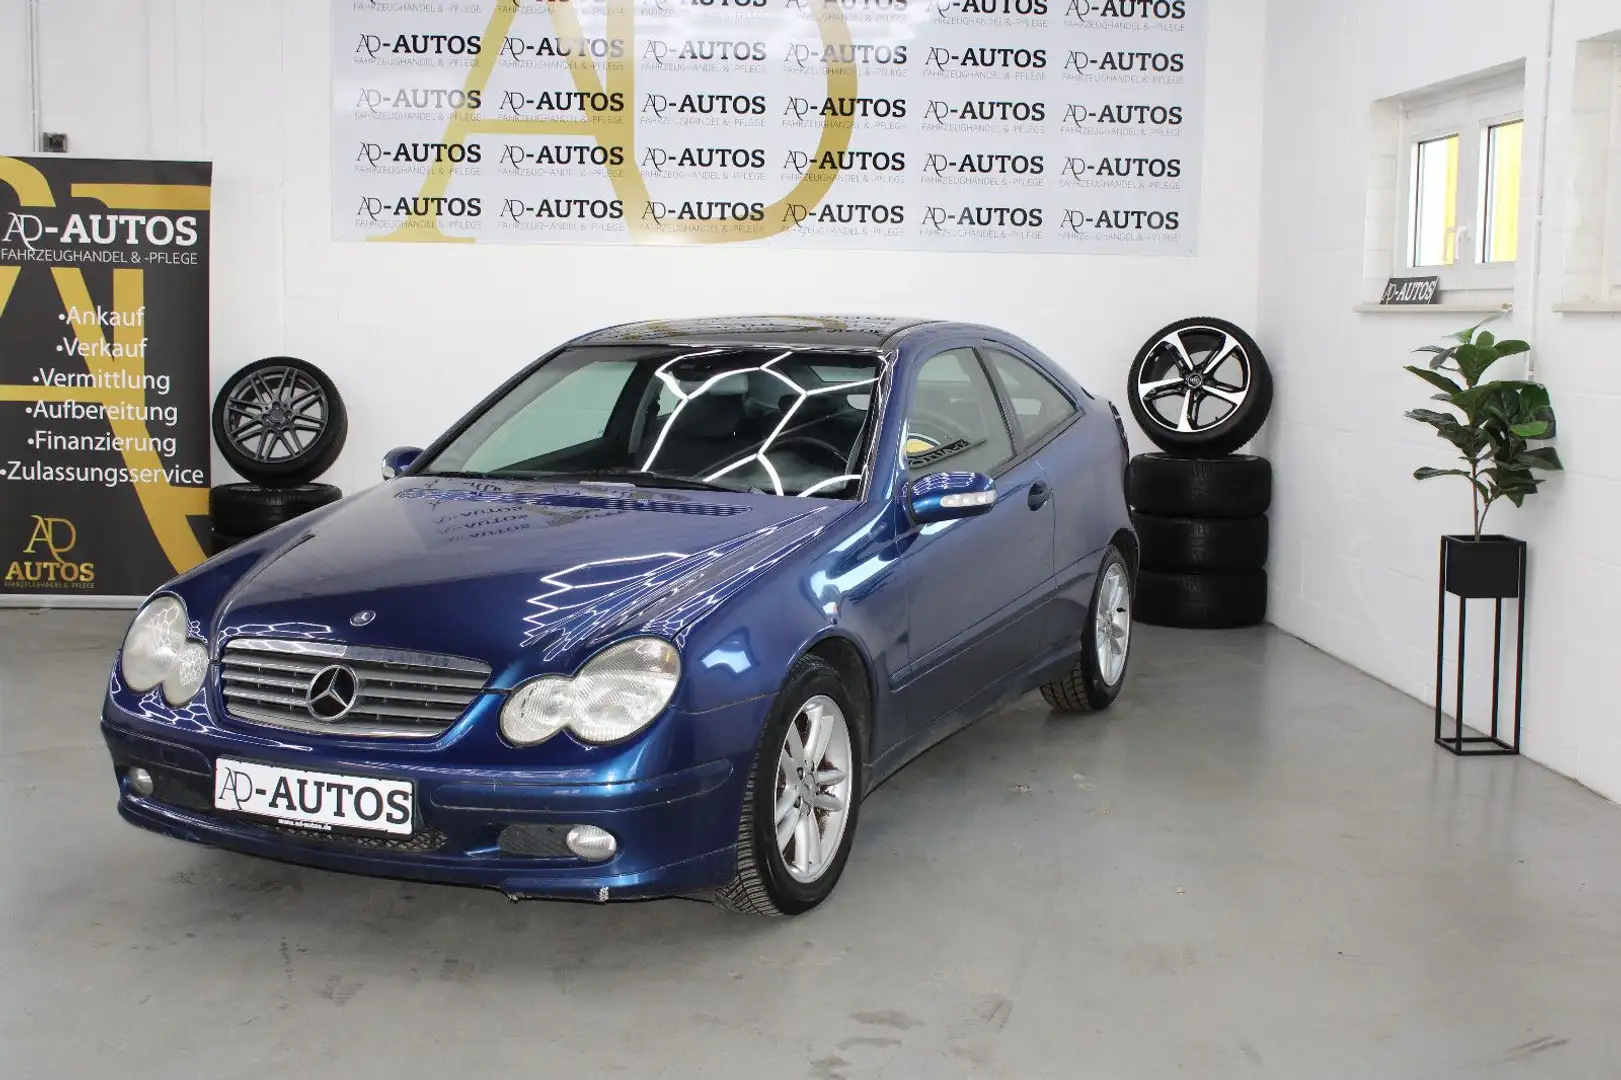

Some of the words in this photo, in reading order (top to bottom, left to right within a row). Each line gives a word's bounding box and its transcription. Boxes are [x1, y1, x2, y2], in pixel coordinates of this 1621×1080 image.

[354, 4, 434, 12] FARZEUGHANDEL
[1065, 0, 1185, 22] AD-AUTOS
[355, 34, 482, 58] AD-AUTOS
[500, 36, 625, 60] AD-AUTOS
[642, 39, 767, 64] AD-AUTOS
[784, 43, 908, 68] AD-AUTOS
[925, 46, 1047, 71] AD-AUTOS
[1064, 50, 1184, 74] AD-AUTOS
[356, 88, 482, 112] AD-AUTOS
[499, 91, 624, 116] AD-AUTOS
[642, 93, 766, 118] AD-AUTOS
[783, 96, 907, 120] AD-AUTOS
[924, 99, 1045, 124] AD-AUTOS
[1063, 103, 1183, 127] AD-AUTOS
[356, 142, 482, 166] AD-AUTOS
[500, 144, 624, 169] AD-AUTOS
[641, 146, 765, 172] AD-AUTOS
[783, 149, 905, 174] AD-AUTOS
[923, 152, 1044, 177] AD-AUTOS
[640, 171, 720, 180] FAHRZEUGANDEL
[1061, 156, 1181, 181] AD-AUTOS
[357, 196, 482, 220] AD-AUTOS
[500, 198, 624, 222] AD-AUTOS
[641, 200, 764, 225] AD-AUTOS
[782, 202, 904, 226] AD-AUTOS
[922, 206, 1043, 230] AD-AUTOS
[2, 211, 198, 251] AD-AUTOS
[1060, 208, 1179, 233] AD-AUTOS
[1, 249, 128, 264] FAHRZEUGHANDEL
[131, 251, 141, 264] &
[144, 251, 198, 265] -PFLEGE
[22, 514, 77, 563] AD
[4, 561, 96, 582] AUTOS
[218, 766, 411, 825] AD-AUTOS
